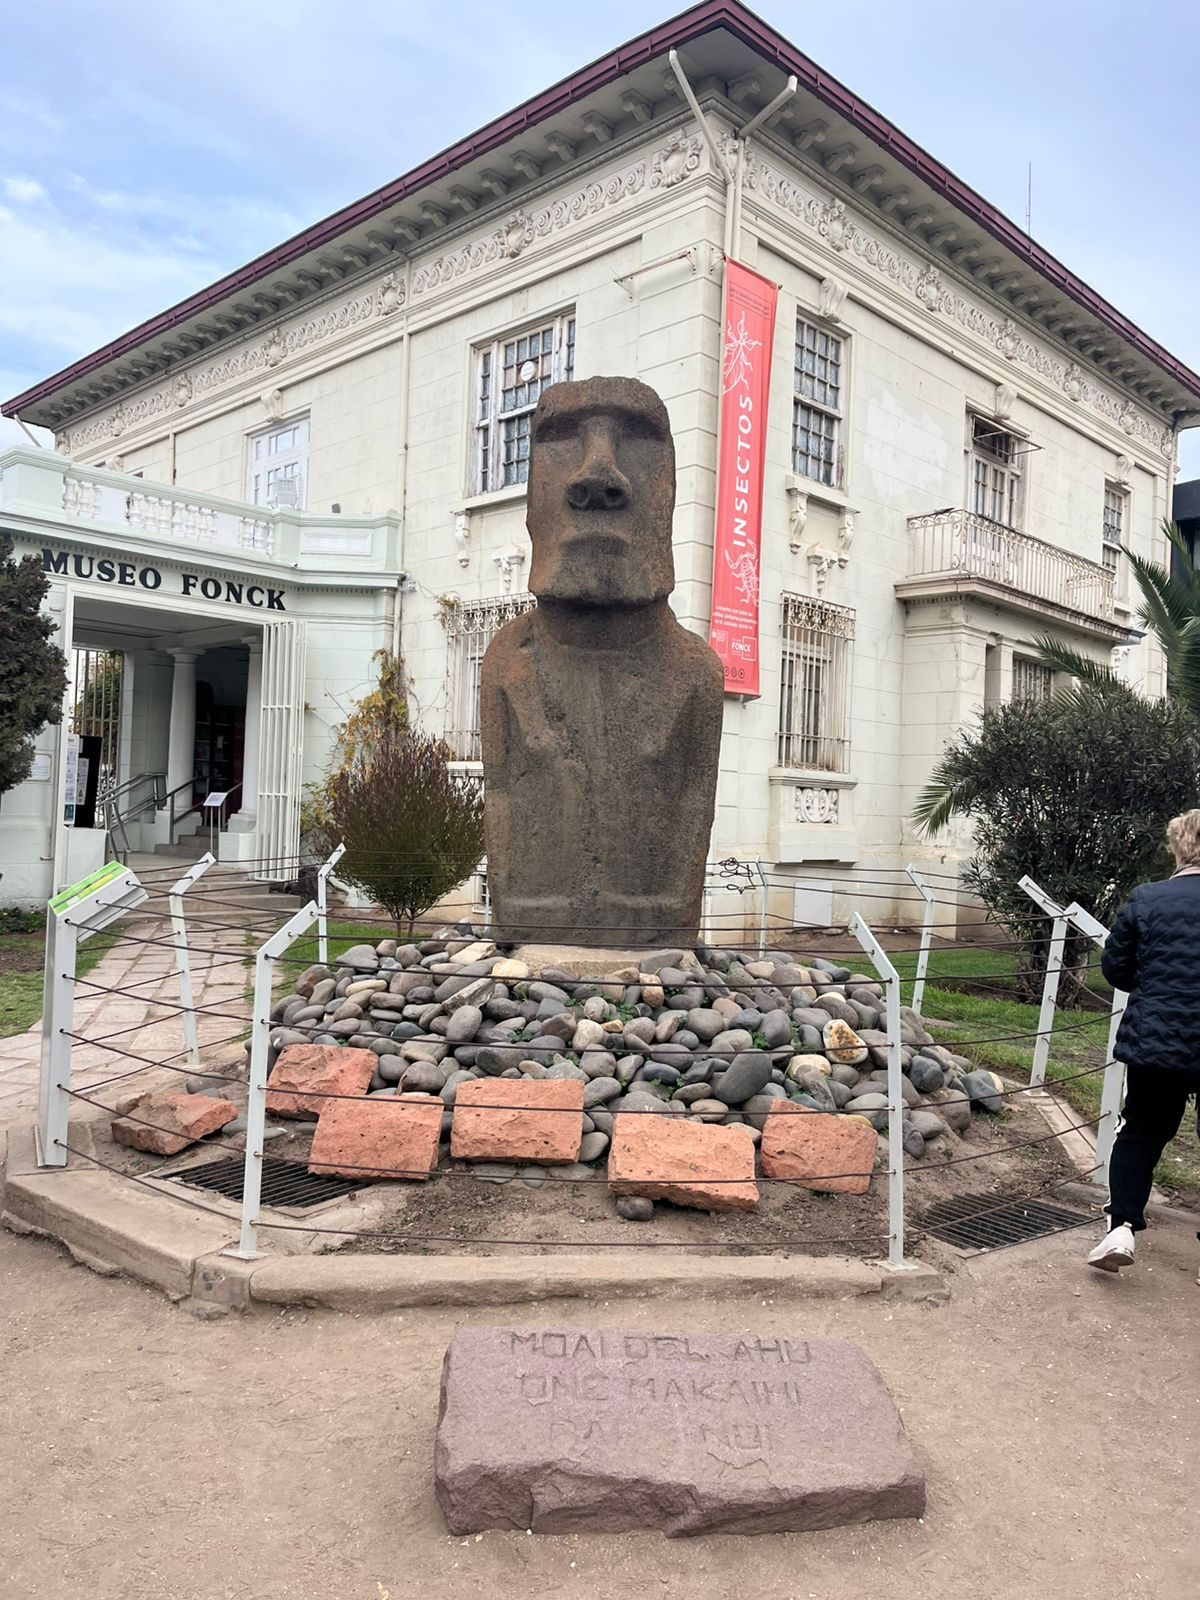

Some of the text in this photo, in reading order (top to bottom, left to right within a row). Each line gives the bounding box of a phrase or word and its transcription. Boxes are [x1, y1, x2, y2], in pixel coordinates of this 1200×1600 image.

[733, 395, 753, 547] INSECTOS
[42, 549, 287, 610] MUSEO FONCK
[509, 1331, 606, 1359] MOAI
[734, 1338, 811, 1364] AHU
